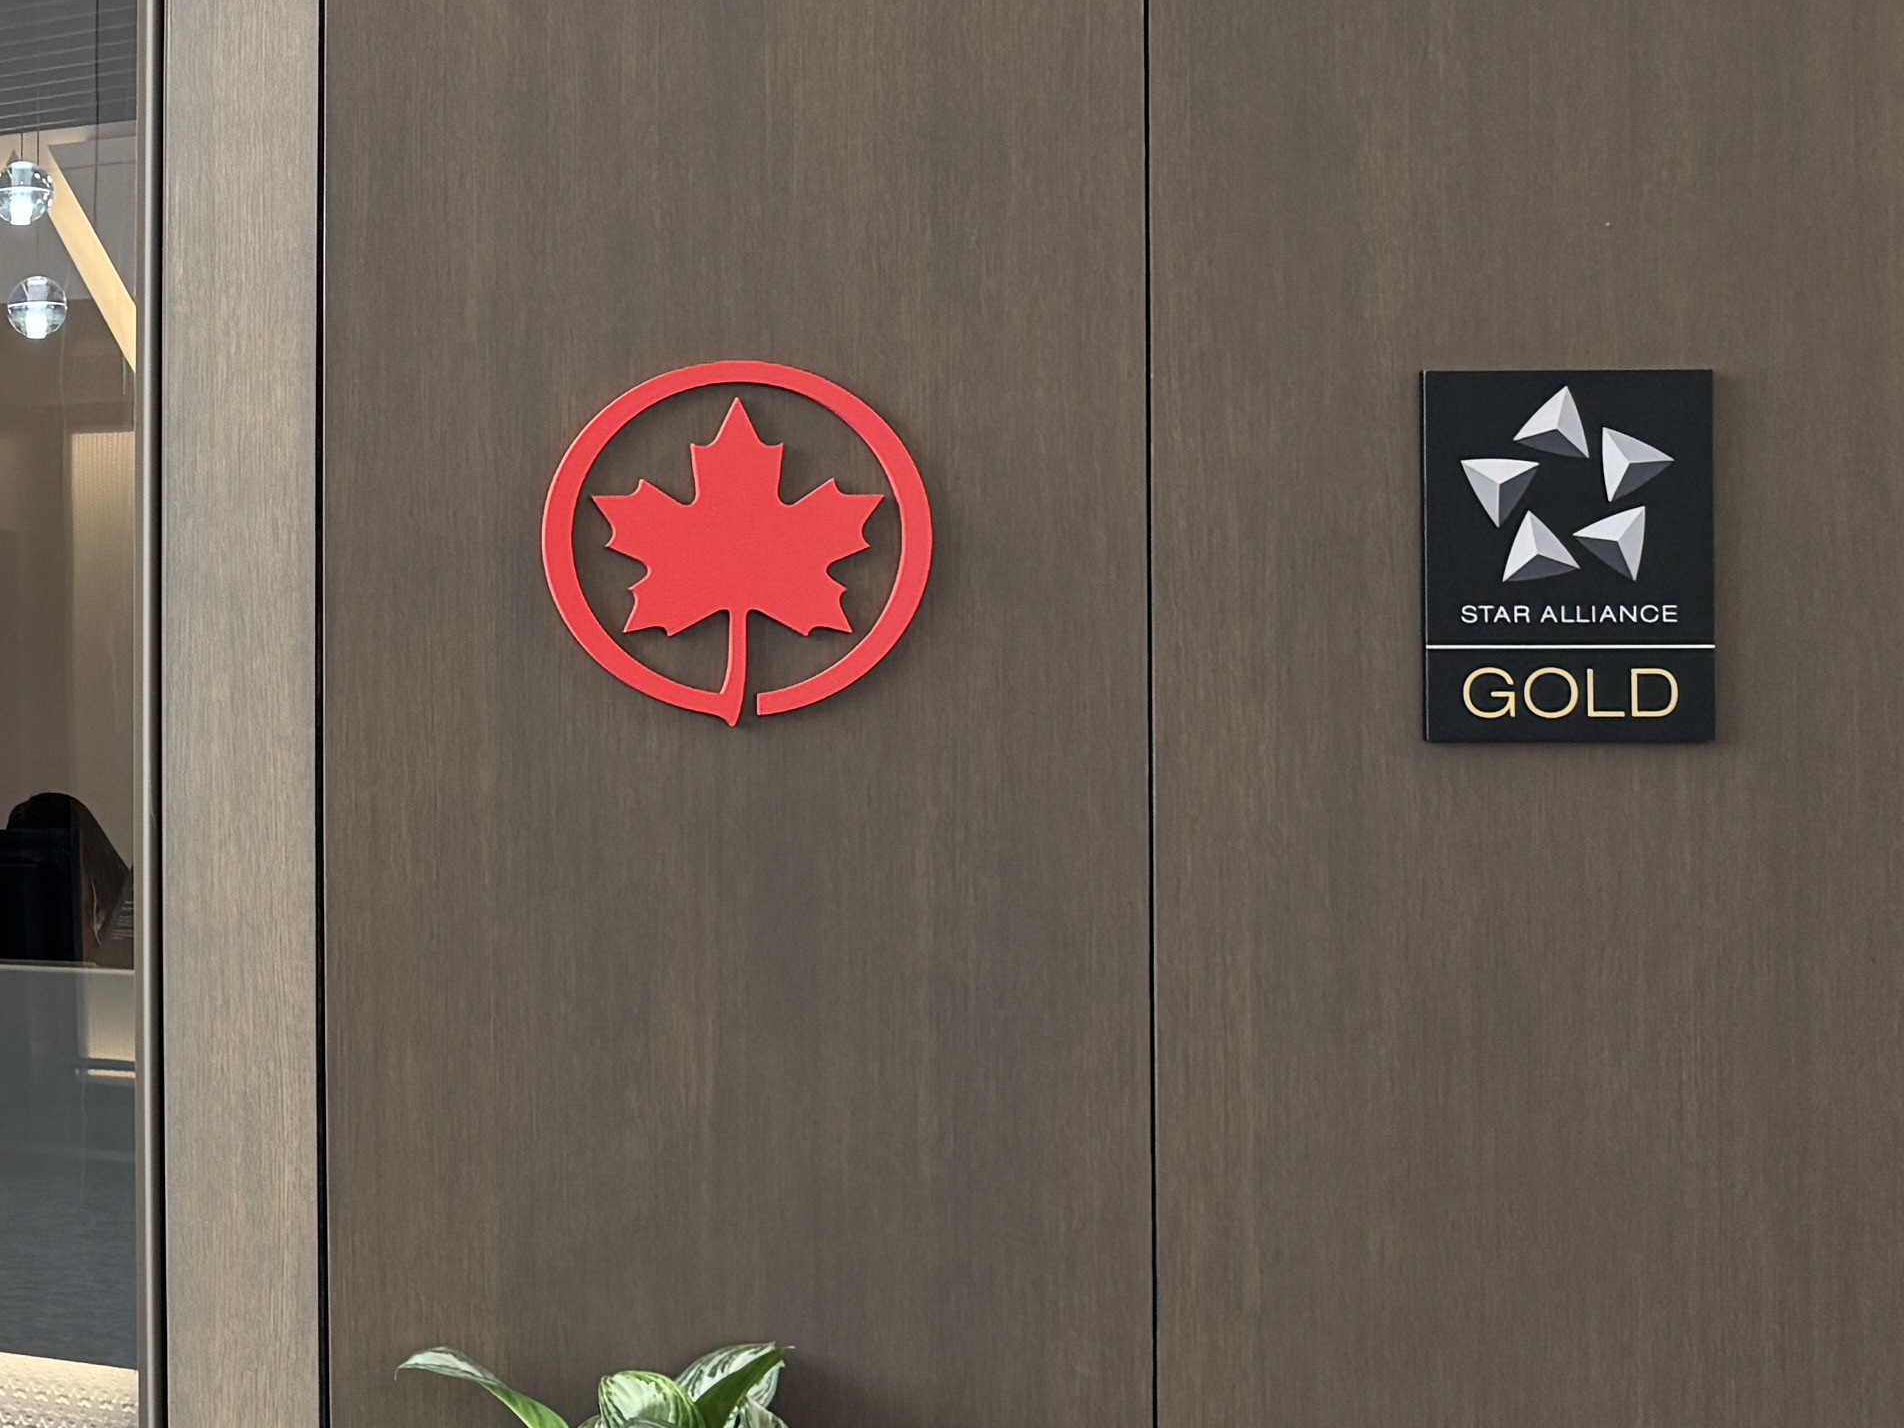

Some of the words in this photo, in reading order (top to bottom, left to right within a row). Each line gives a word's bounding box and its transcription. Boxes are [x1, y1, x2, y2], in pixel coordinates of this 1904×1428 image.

[1461, 605, 1530, 623] STAR
[1541, 605, 1677, 623] ALLIANCE
[1463, 667, 1678, 718] GOLD
